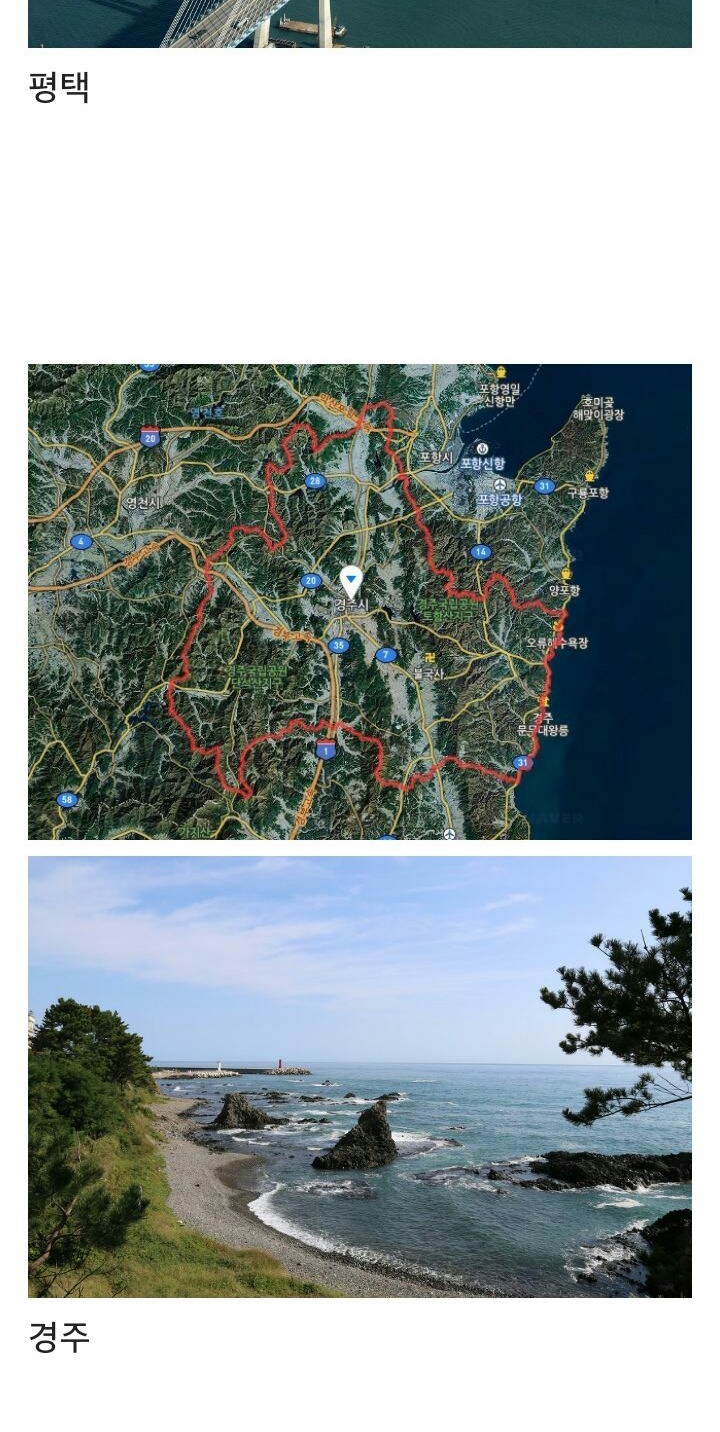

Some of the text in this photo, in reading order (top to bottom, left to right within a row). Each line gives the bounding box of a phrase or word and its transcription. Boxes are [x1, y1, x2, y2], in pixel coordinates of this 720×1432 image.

[479, 384, 520, 395] 포항영일
[419, 452, 453, 464] 포항시
[127, 496, 161, 510] 영천시
[477, 495, 523, 506] 포항공항
[549, 585, 581, 597] 양포항
[336, 599, 369, 611] 경주시
